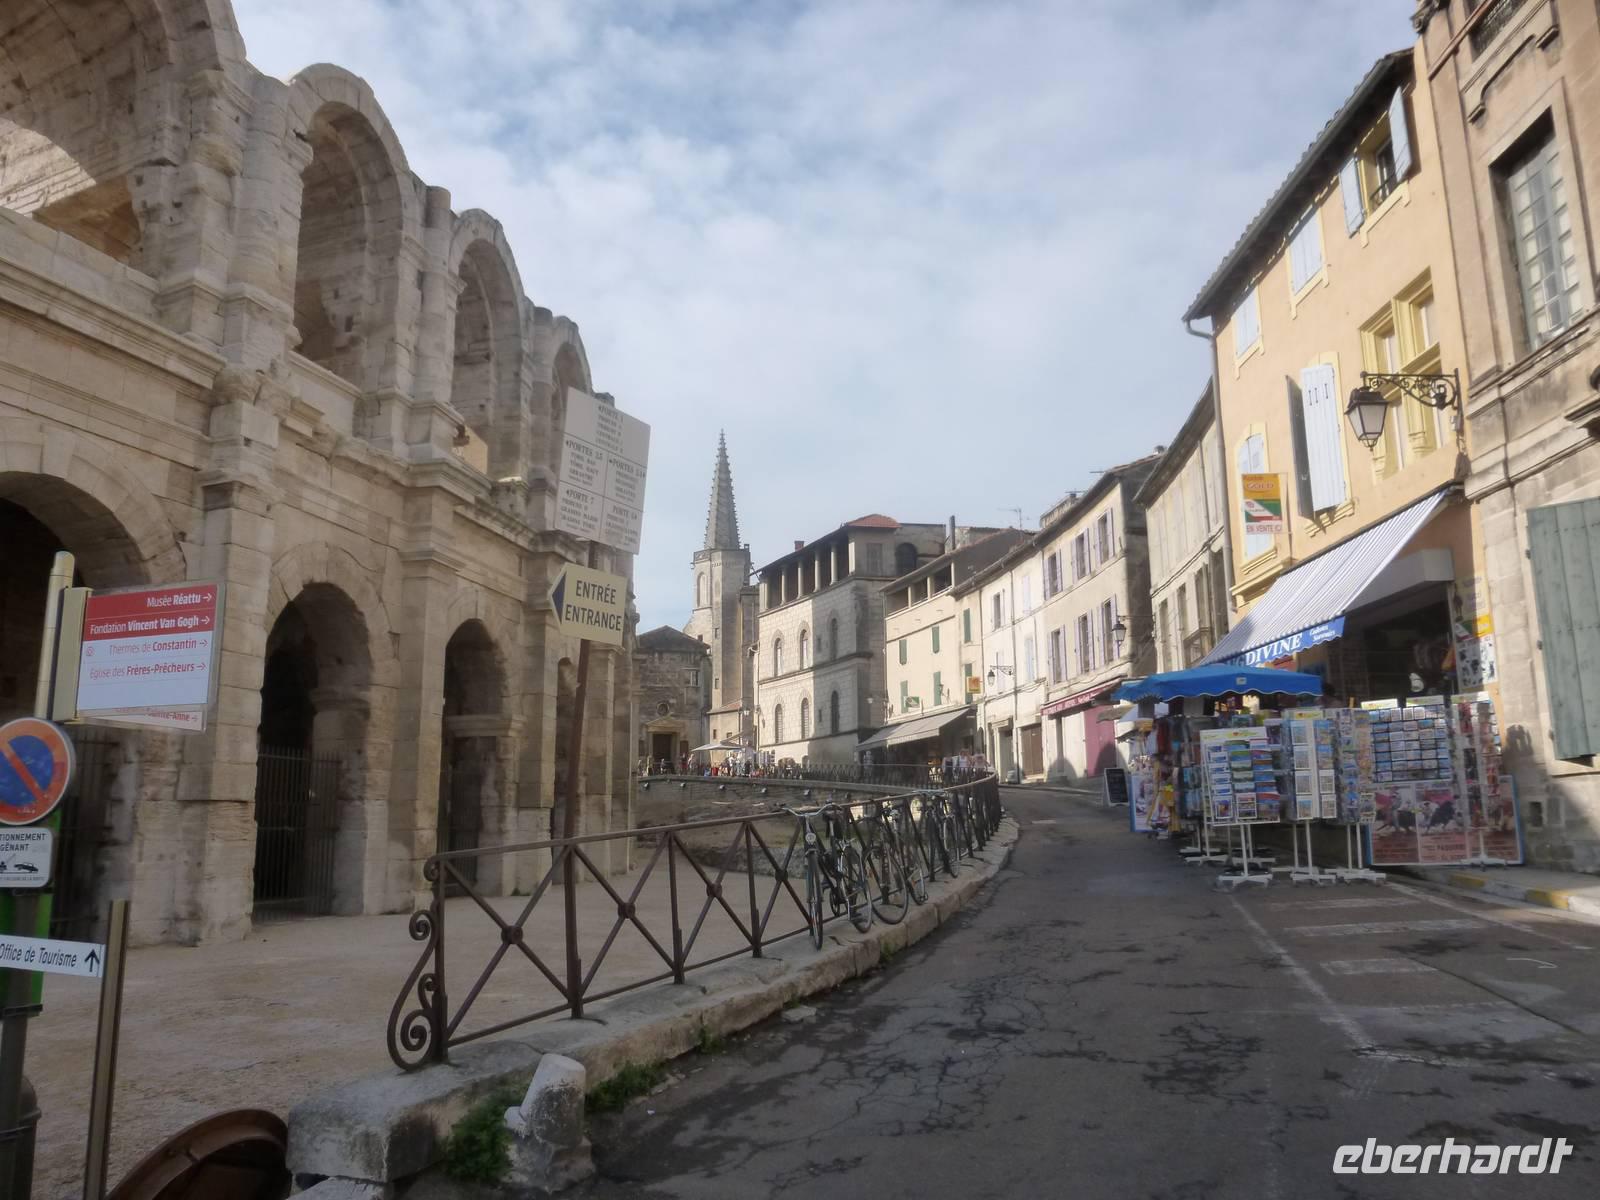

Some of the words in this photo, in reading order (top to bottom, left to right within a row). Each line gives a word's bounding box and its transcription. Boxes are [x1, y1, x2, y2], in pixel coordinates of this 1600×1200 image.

[1256, 524, 1273, 533] VENTE
[147, 596, 172, 608] Musée
[173, 593, 201, 605] Réattu
[576, 580, 616, 605] ENTRÉE
[90, 621, 126, 634] Fondation
[128, 619, 159, 632] Vincent
[160, 617, 176, 629] Van
[177, 615, 199, 629] Gogh
[565, 604, 622, 631] ENTRANCE
[109, 644, 139, 656] Thermes
[142, 643, 151, 653] de
[152, 639, 196, 652] Constantin
[126, 662, 194, 677] Frères-Prêcheurs
[0, 943, 22, 961] Office
[24, 946, 36, 963] de
[38, 947, 77, 967] Tourisme
